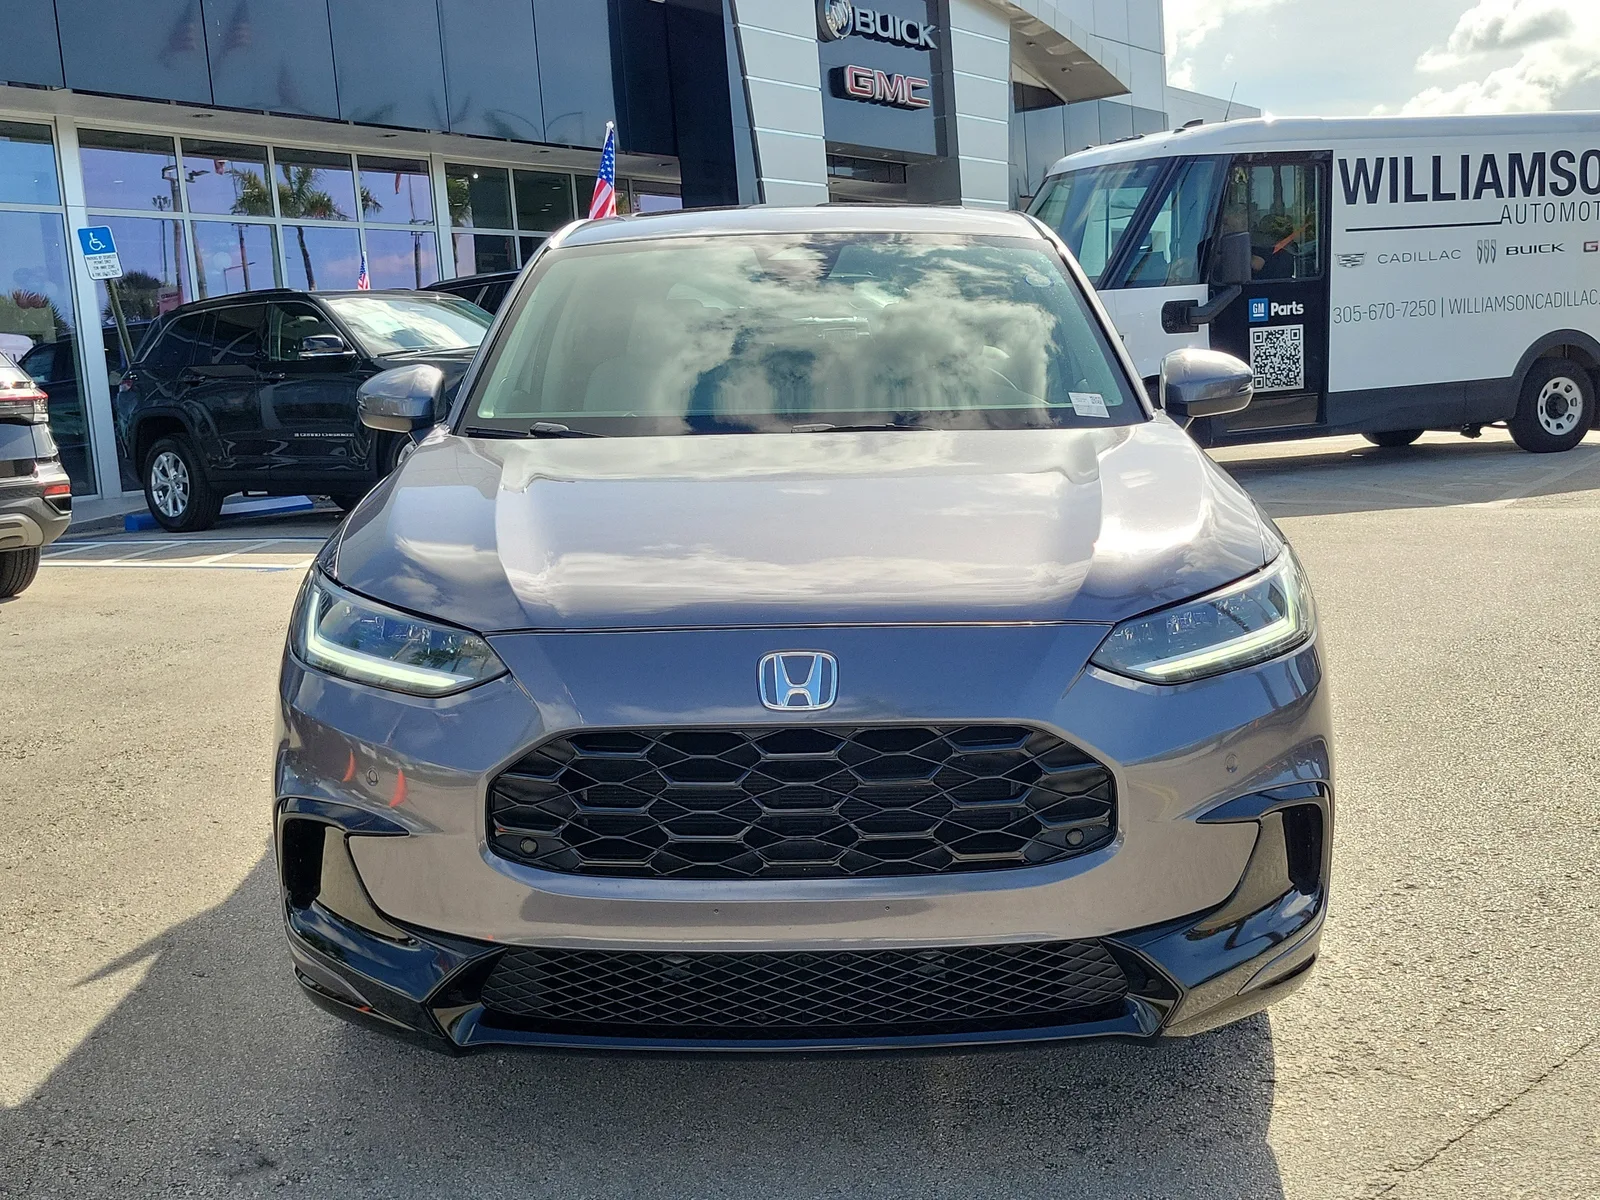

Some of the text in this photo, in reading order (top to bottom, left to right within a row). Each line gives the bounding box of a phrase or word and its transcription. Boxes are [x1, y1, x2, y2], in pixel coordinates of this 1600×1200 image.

[854, 7, 938, 49] BUICK
[844, 64, 931, 108] GMC
[1337, 149, 1600, 205] WILLIAMSO
[1377, 249, 1462, 265] CADILLAC
[1506, 243, 1565, 256] BUICK
[1253, 301, 1304, 317] GM Parts
[1333, 299, 1437, 324] 305-670-7250
